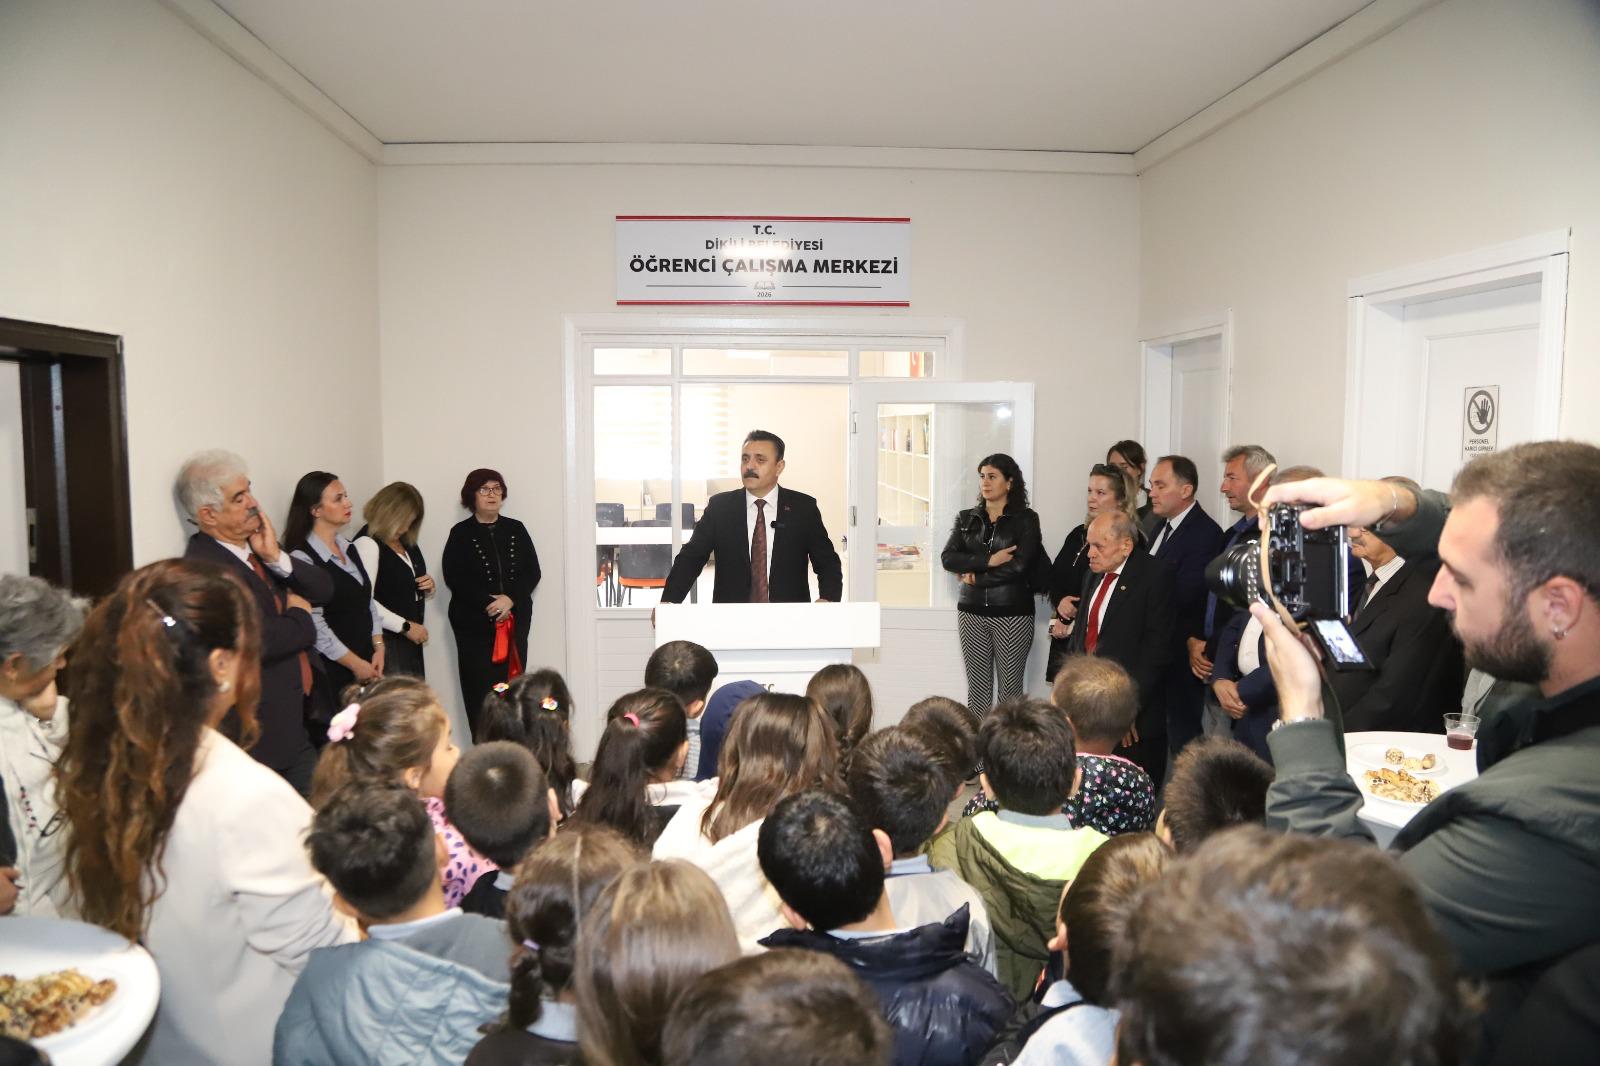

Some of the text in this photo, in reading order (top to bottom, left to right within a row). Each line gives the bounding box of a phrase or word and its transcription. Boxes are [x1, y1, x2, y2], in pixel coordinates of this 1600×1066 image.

[752, 225, 776, 235] T.C.
[629, 254, 898, 277] ÖĞRENCİ ÇALIŞMA MERKEZİ
